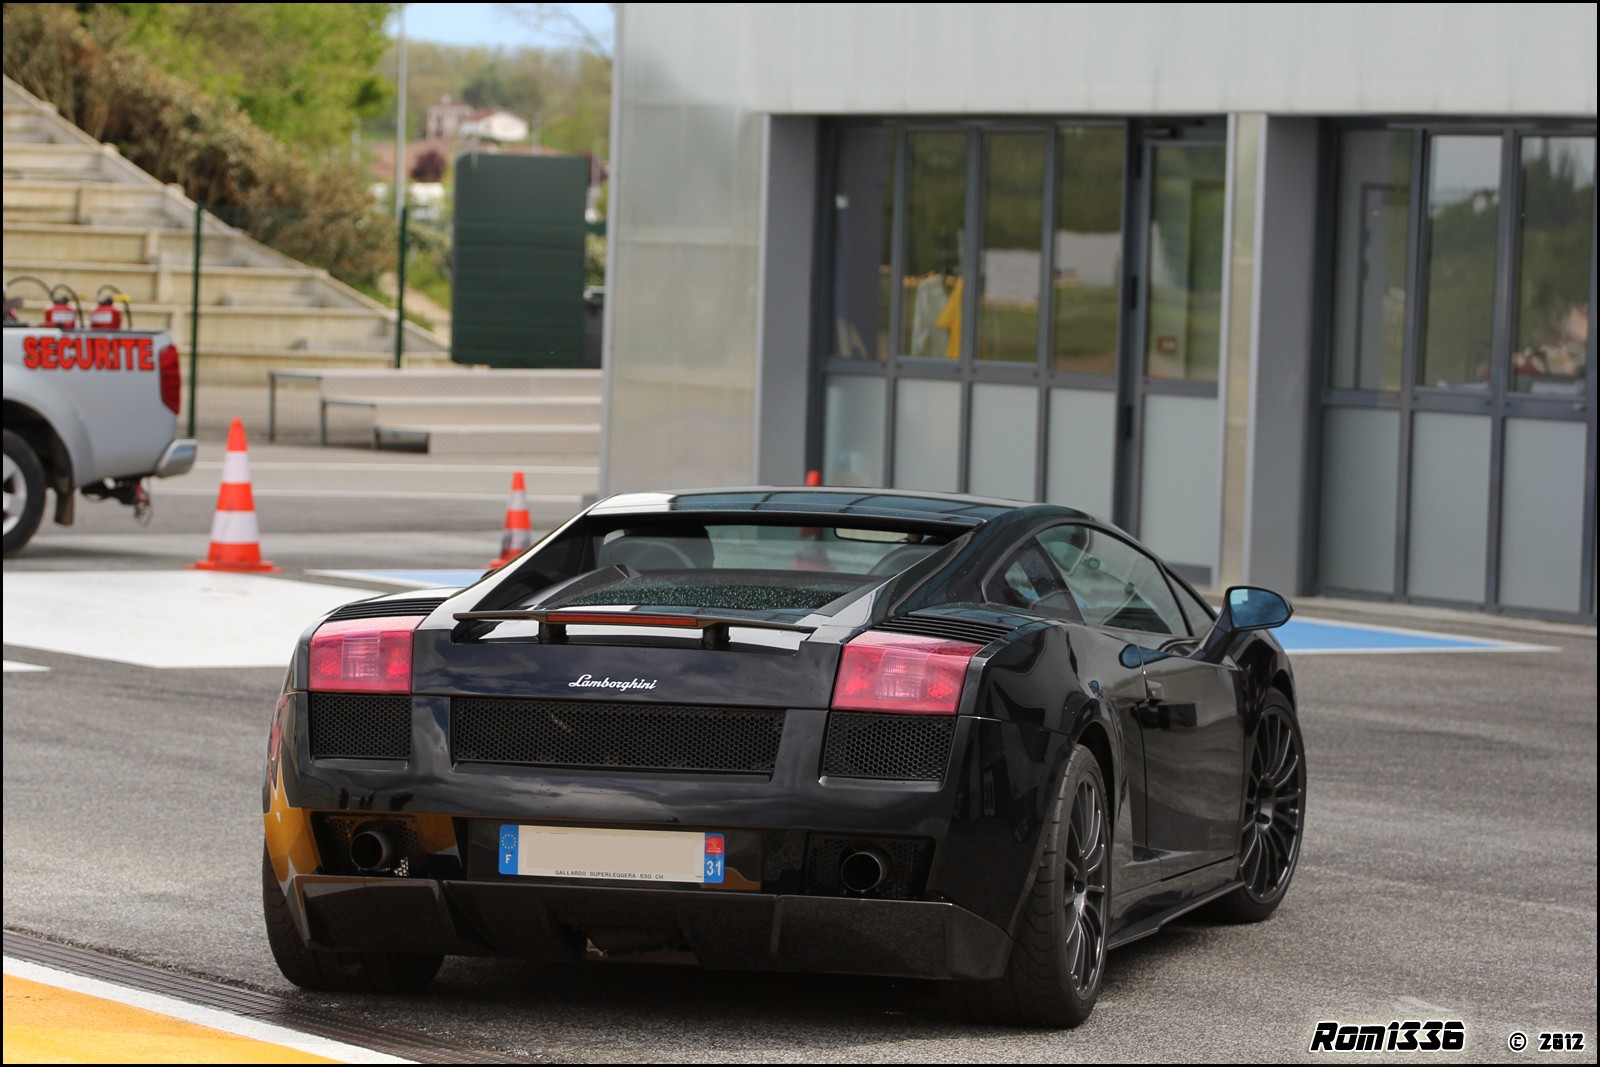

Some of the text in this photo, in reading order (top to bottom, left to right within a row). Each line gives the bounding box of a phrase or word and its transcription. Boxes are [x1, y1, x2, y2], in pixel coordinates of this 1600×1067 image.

[23, 335, 155, 371] SECURITE
[568, 673, 658, 692] Lamborghini
[505, 853, 512, 864] F
[554, 869, 587, 877] GALLARDO
[589, 871, 636, 879] SUPERLEGGERA
[706, 860, 721, 877] 31
